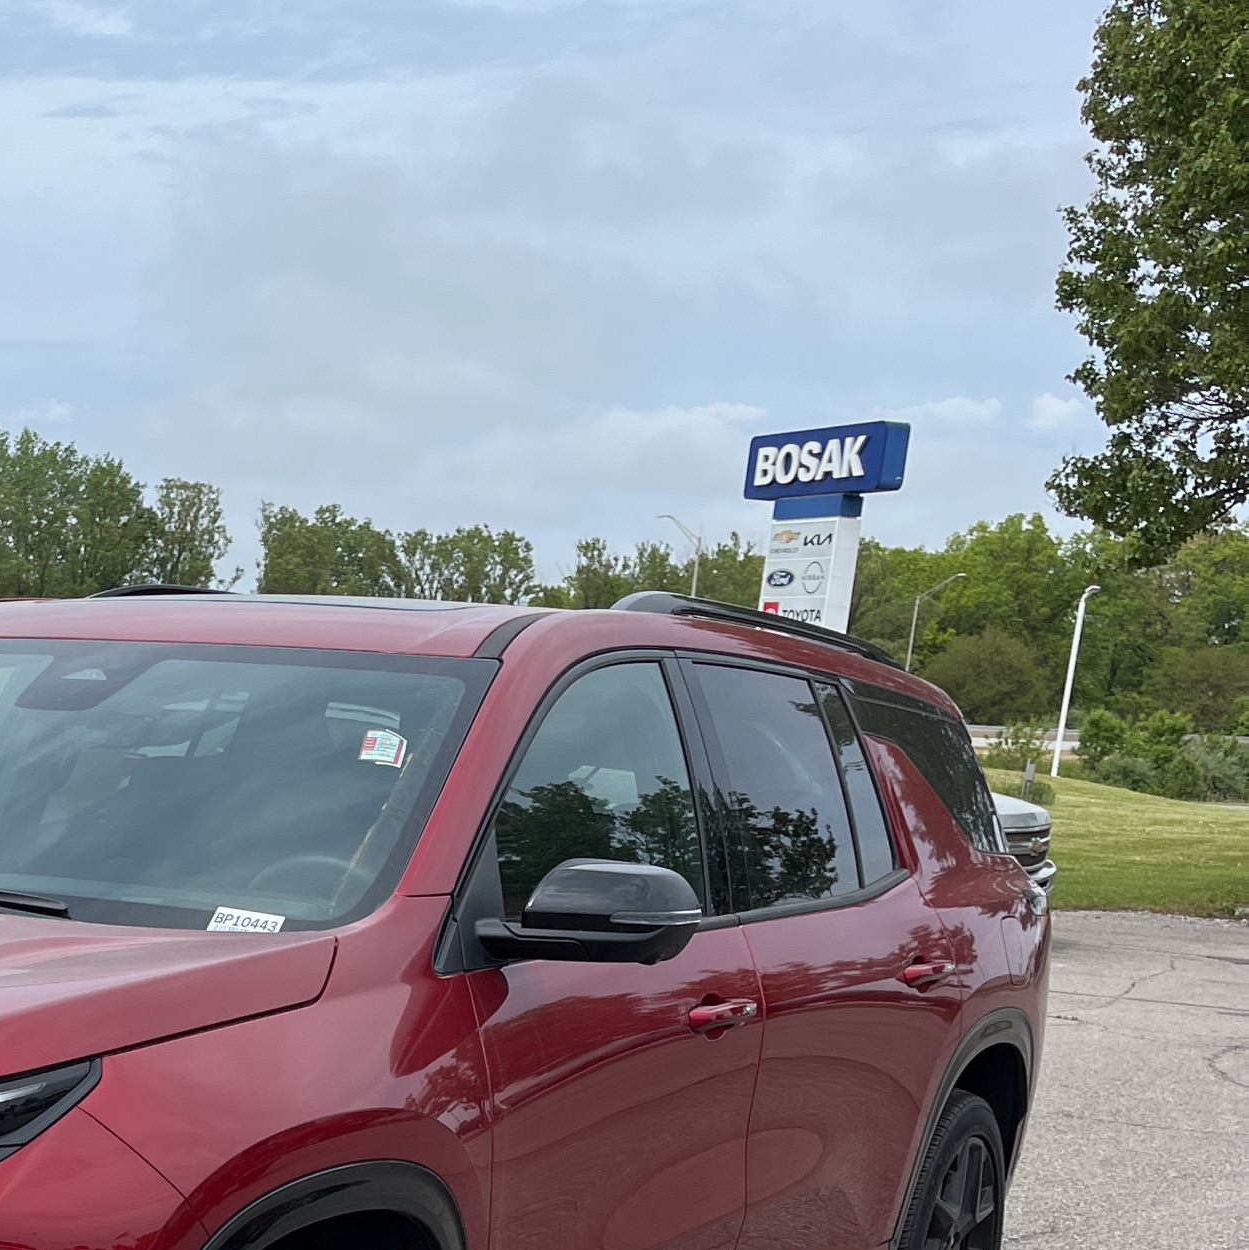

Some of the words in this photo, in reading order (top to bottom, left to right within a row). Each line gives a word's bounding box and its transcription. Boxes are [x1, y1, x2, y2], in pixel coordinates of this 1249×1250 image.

[753, 434, 868, 487] BOSAK
[803, 532, 833, 547] KIA
[782, 609, 822, 622] TOYOTA
[214, 912, 279, 933] BP10443
